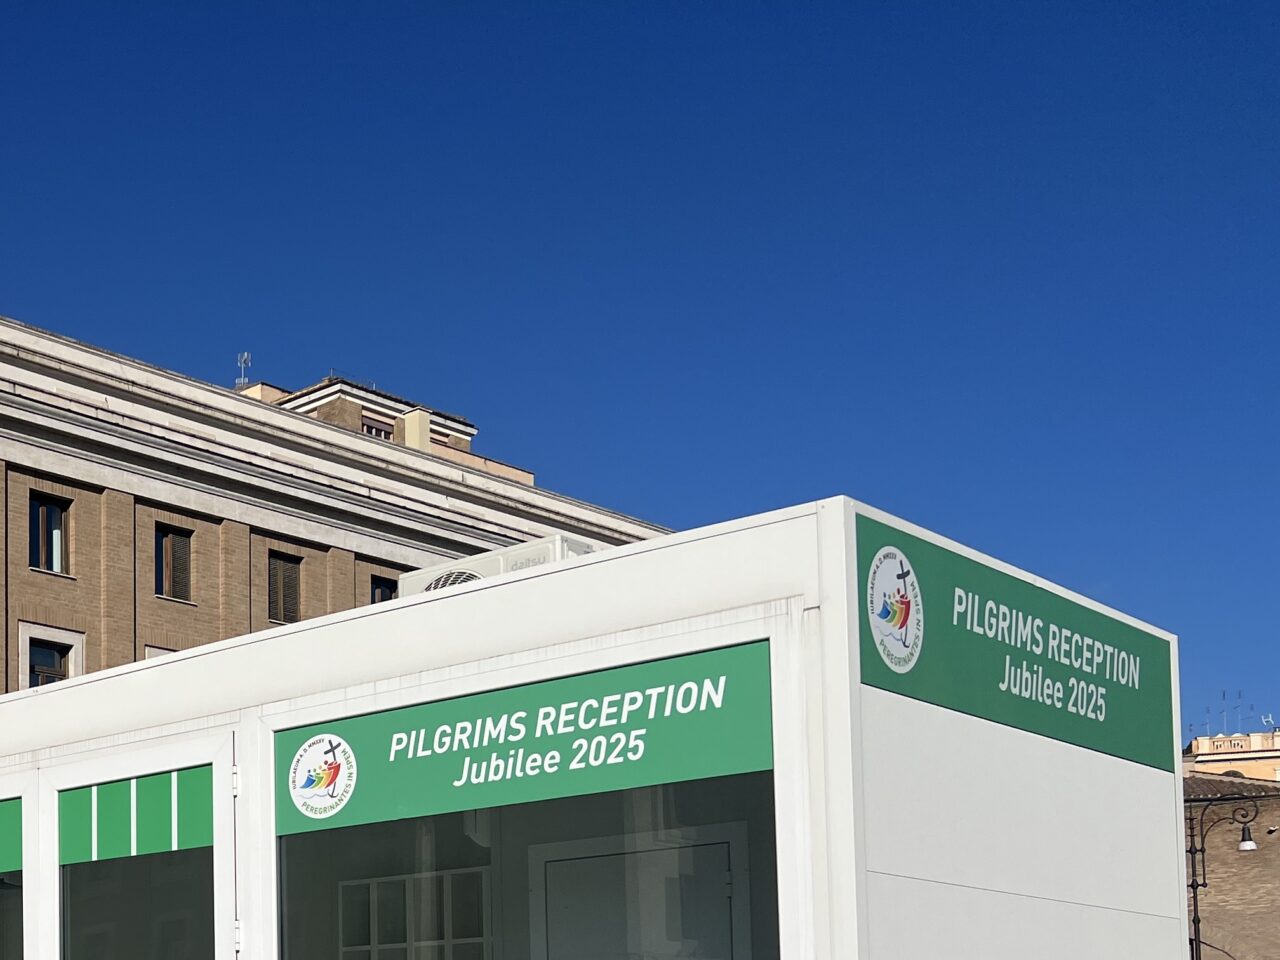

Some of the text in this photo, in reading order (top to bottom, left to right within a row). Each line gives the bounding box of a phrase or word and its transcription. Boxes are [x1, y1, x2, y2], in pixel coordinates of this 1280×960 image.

[952, 586, 1141, 690] PILGRIMS RECEPTION
[388, 675, 727, 762] PILGRIMS RECEPTION
[998, 655, 1107, 722] Jubilee 2025
[452, 728, 647, 788] Jubilee 2025
